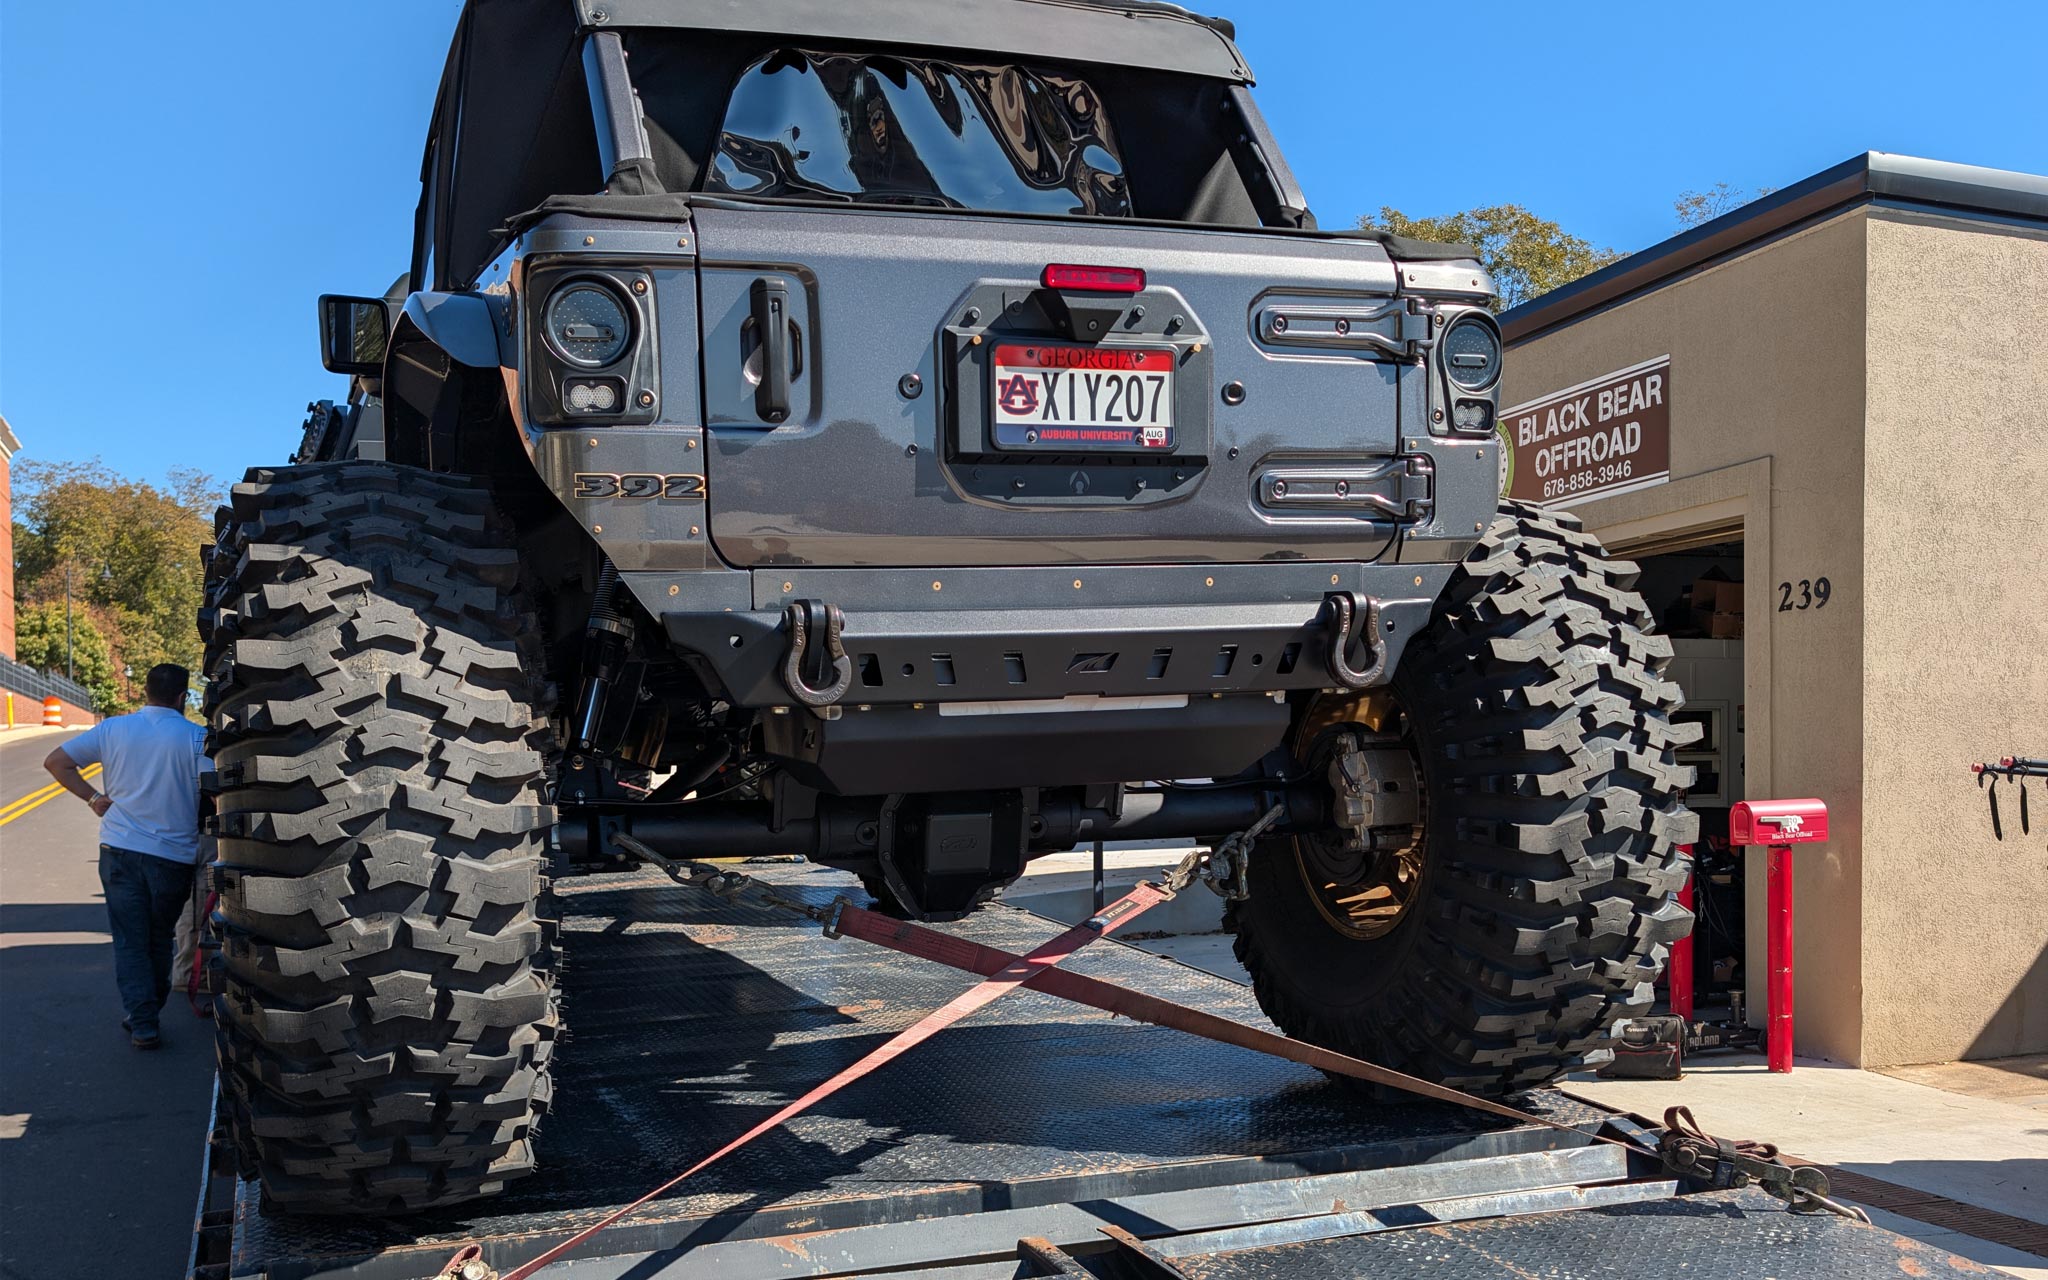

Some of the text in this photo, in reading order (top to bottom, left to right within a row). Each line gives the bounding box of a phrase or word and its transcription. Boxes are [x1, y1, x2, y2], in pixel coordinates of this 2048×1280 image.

[1037, 347, 1137, 369] GEORGIA
[1041, 372, 1165, 423] XIY207
[1518, 374, 1663, 447] BLACK BEAR
[1040, 429, 1133, 441] AUBURN UNIVERSITY
[1145, 430, 1163, 438] AUG
[1535, 421, 1641, 478] OFFROAD
[574, 472, 707, 500] 392
[1543, 459, 1632, 498] 678-858-3946
[1778, 576, 1832, 613] 239
[1688, 1034, 1720, 1048] ADLAND
